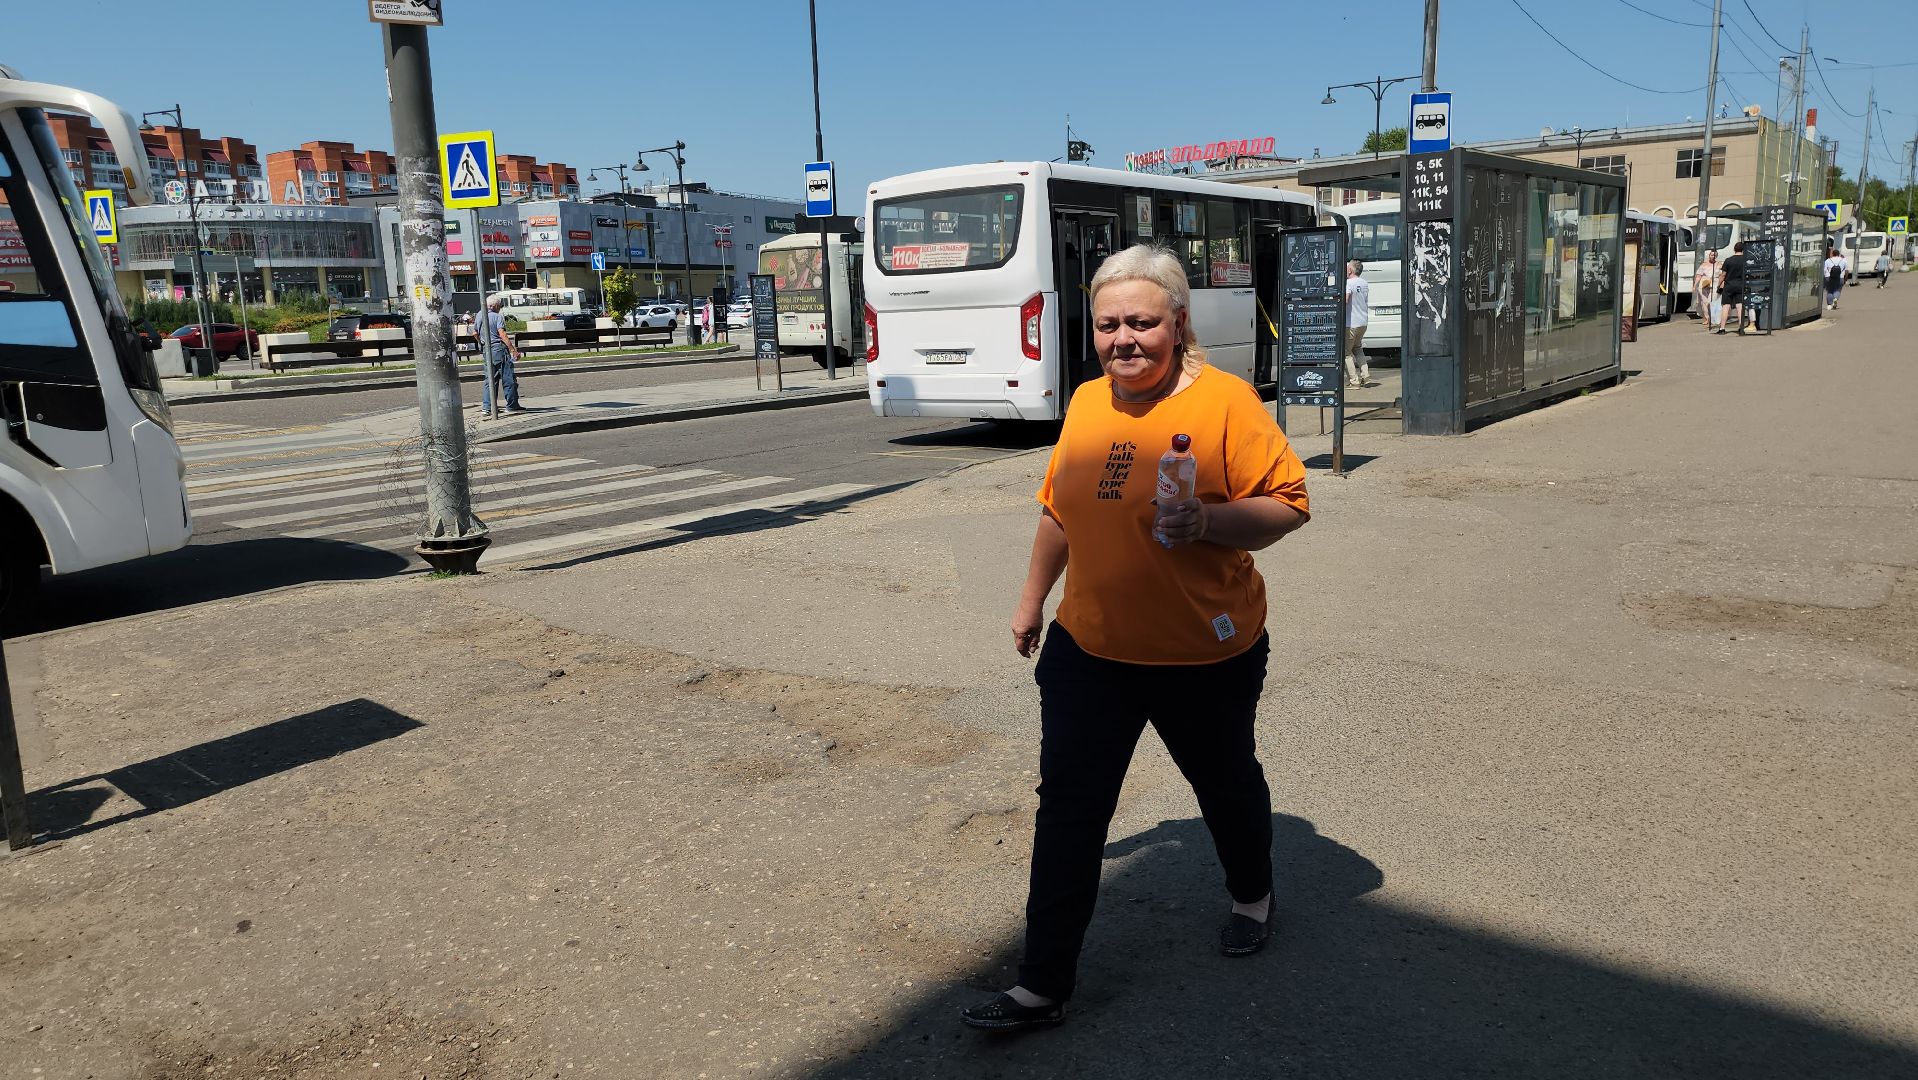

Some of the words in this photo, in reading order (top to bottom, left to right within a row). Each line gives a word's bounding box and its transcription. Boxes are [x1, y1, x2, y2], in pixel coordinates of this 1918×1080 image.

[1170, 137, 1275, 164] ЭЛЬДОРАДО
[1416, 160, 1426, 171] 5,
[1414, 174, 1430, 185] 10,
[1432, 171, 1444, 182] 11
[194, 179, 328, 203] АТЛАС
[1435, 184, 1449, 196] 54
[273, 209, 327, 218] ЦЕНТР
[484, 218, 513, 227] ZENDEN
[1110, 441, 1137, 452] let's
[1108, 452, 1134, 461] talk
[1105, 461, 1132, 471] type
[1112, 468, 1130, 479] let
[1099, 480, 1125, 490] type
[1098, 490, 1122, 500] talk
